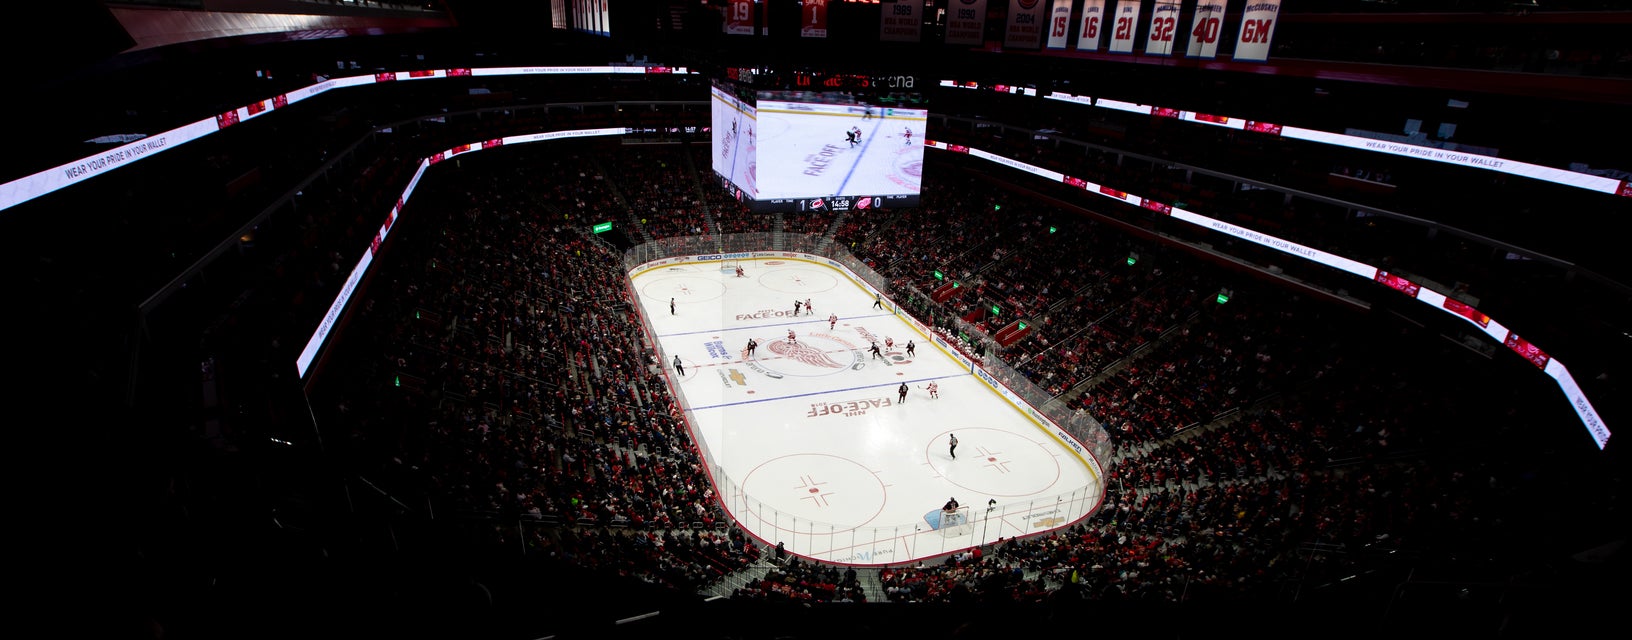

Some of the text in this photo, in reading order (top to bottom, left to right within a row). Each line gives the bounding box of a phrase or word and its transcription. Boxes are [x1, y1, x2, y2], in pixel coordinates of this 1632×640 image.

[733, 2, 749, 20] 19
[811, 6, 818, 24] 1
[892, 4, 912, 16] 1989
[1015, 13, 1035, 25] 2004
[1052, 17, 1067, 37] 15
[1082, 17, 1099, 39] 16
[1115, 17, 1134, 40] 21
[1151, 17, 1176, 41] 32
[1193, 18, 1220, 44] 40
[1241, 19, 1272, 43] GM
[65, 137, 167, 179] WEAR YOUR PRIDE IN YOUR WALLET
[1366, 140, 1504, 168] WEAR YOUR PRIDE IN YOUR WALLET
[800, 200, 806, 211] 1
[831, 199, 850, 208] 14:58
[874, 196, 881, 208] 0
[1212, 222, 1228, 230] WEAR
[1229, 226, 1245, 235] YOUR
[1245, 231, 1262, 241] PRIDE
[1272, 239, 1289, 249] YOUR
[1290, 244, 1317, 257] WALLET
[735, 309, 797, 321] FACE-OF
[807, 397, 892, 418] FACE-OFF
[1058, 431, 1082, 454] FALKEN
